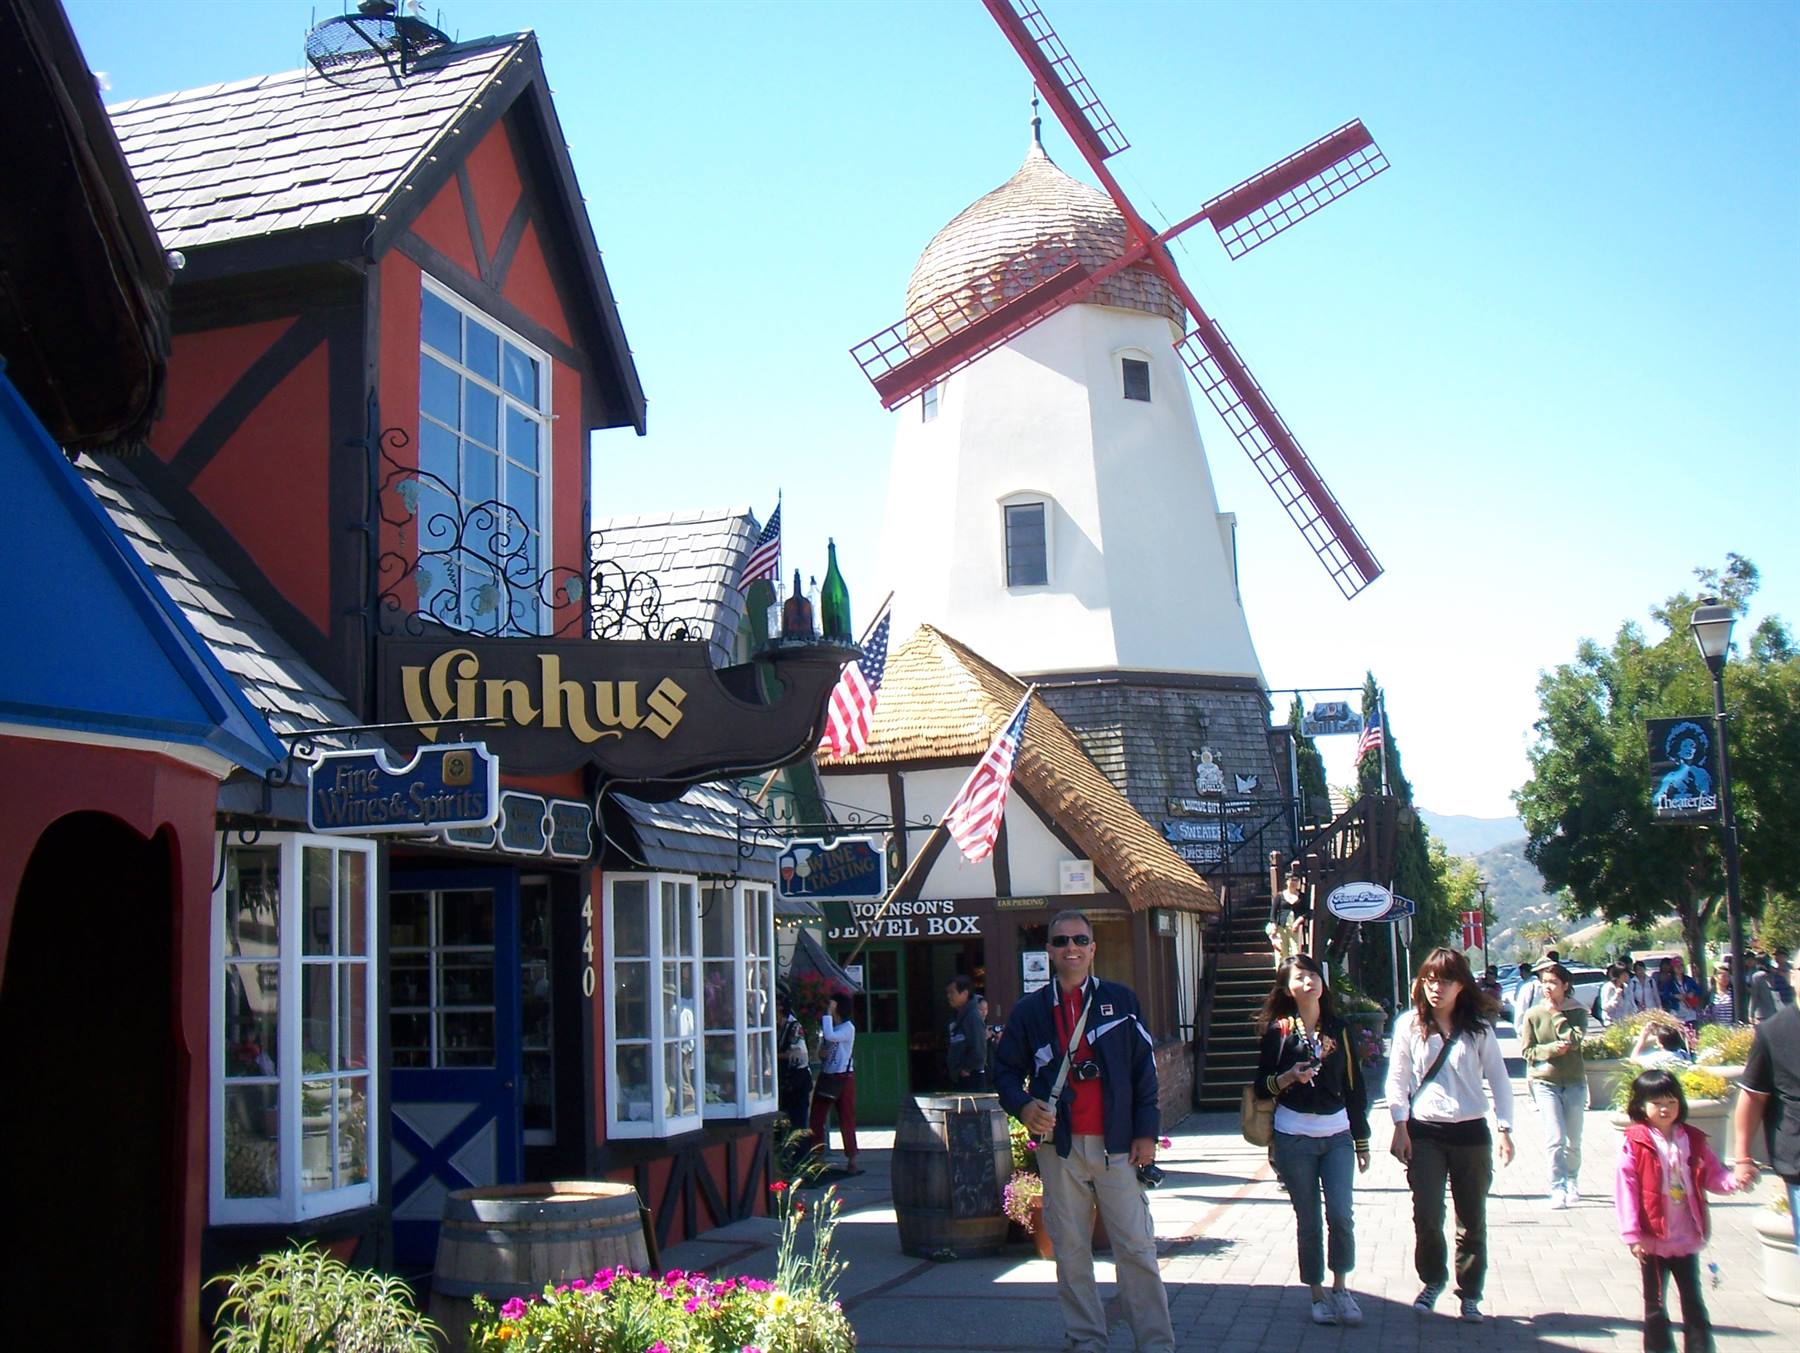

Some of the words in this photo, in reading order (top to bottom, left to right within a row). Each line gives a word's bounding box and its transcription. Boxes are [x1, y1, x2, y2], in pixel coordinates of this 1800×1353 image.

[401, 649, 687, 743] Vinhus
[336, 764, 379, 793] Fine
[318, 787, 389, 825] Wines
[390, 792, 405, 817] &
[407, 781, 484, 826] Spirits
[806, 845, 857, 872] WINE
[809, 857, 875, 890] TASTING
[854, 901, 954, 918] JOHNSON'S
[828, 918, 919, 939] JEWEL
[927, 916, 981, 935] BOX
[582, 894, 595, 997] 440
